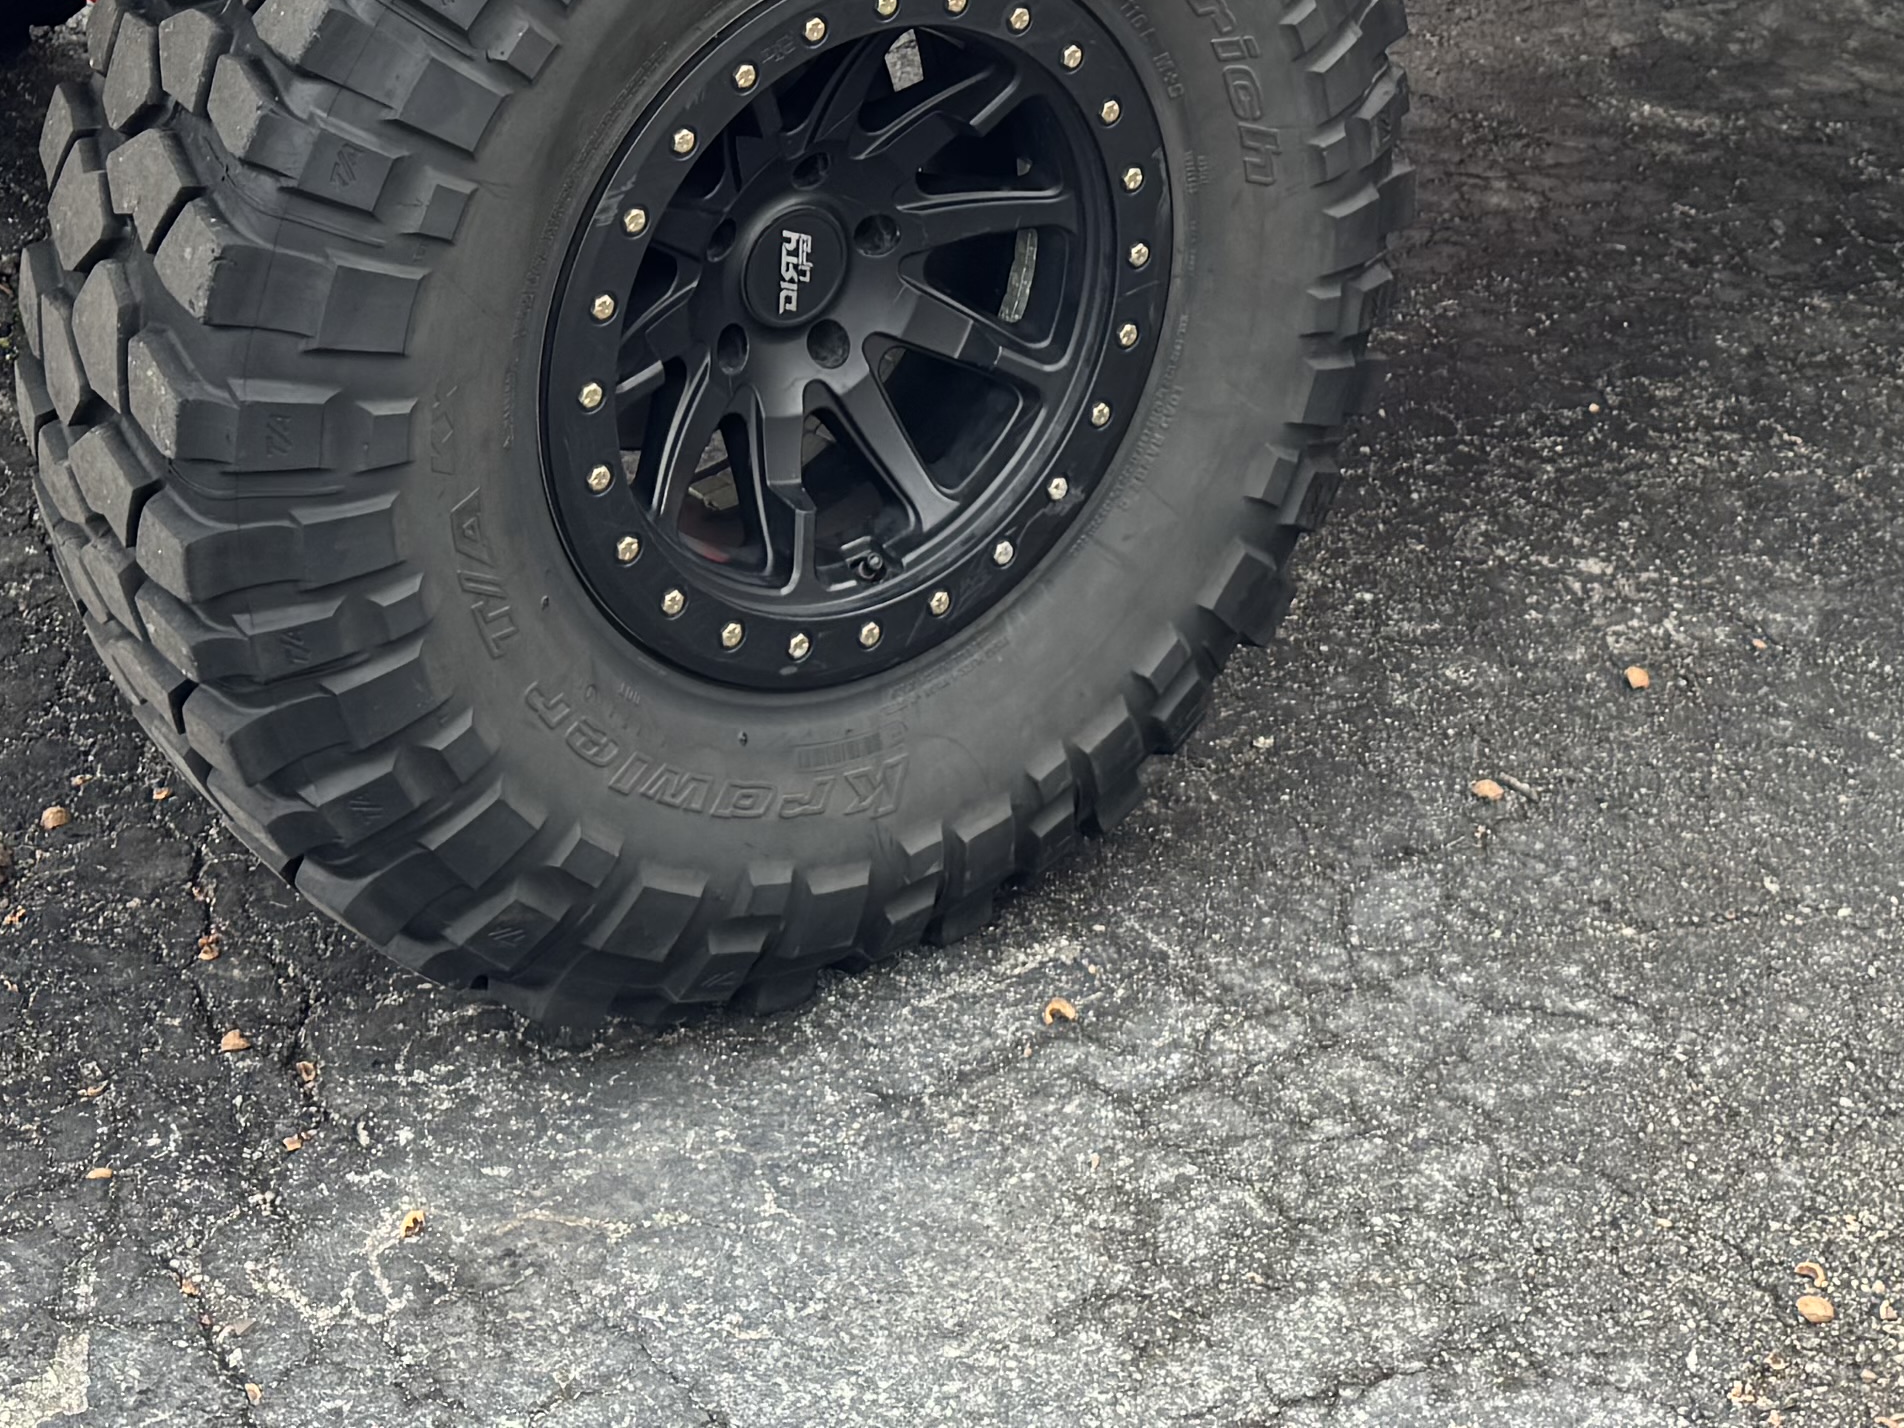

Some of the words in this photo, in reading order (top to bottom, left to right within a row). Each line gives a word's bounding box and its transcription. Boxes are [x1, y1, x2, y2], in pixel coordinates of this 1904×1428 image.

[777, 228, 800, 316] DIRTY
[449, 486, 521, 662] T/A
[524, 678, 911, 820] Krawler
